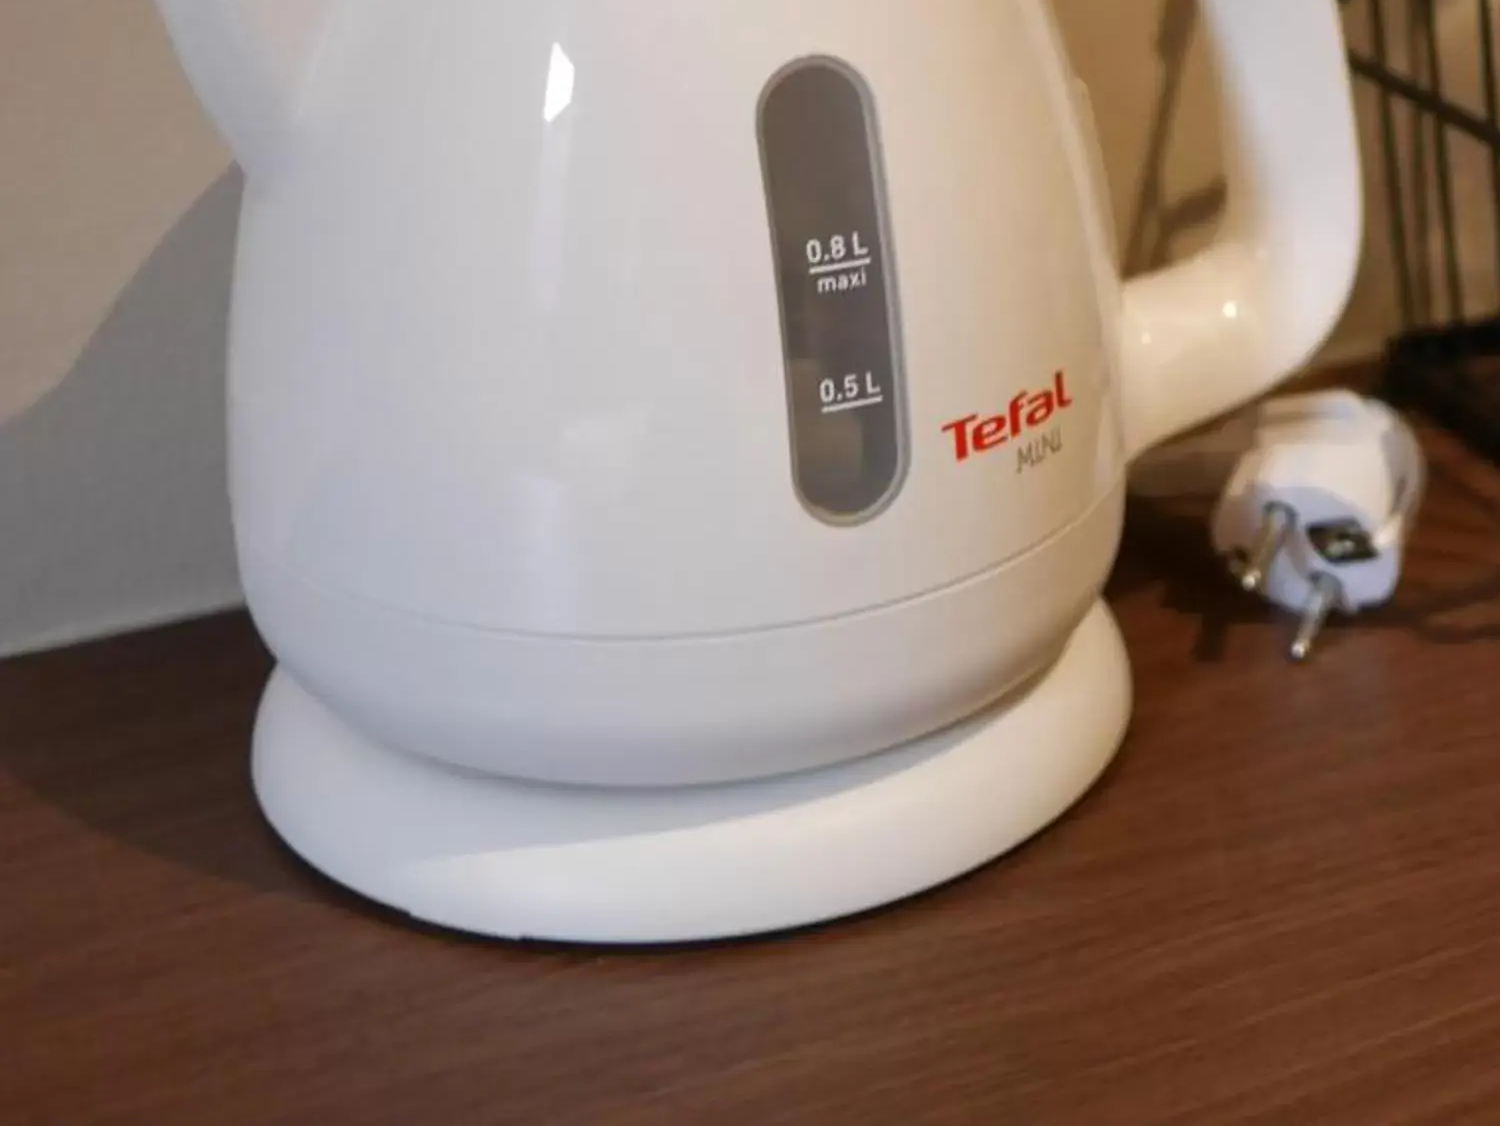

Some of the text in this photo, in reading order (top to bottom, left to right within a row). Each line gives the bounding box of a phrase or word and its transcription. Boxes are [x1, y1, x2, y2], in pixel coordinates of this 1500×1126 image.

[805, 231, 869, 265] 0.8 L
[816, 267, 867, 293] maxi
[819, 370, 881, 404] 0.5 L
[941, 370, 1073, 463] Tefal
[1017, 427, 1063, 473] MINI
